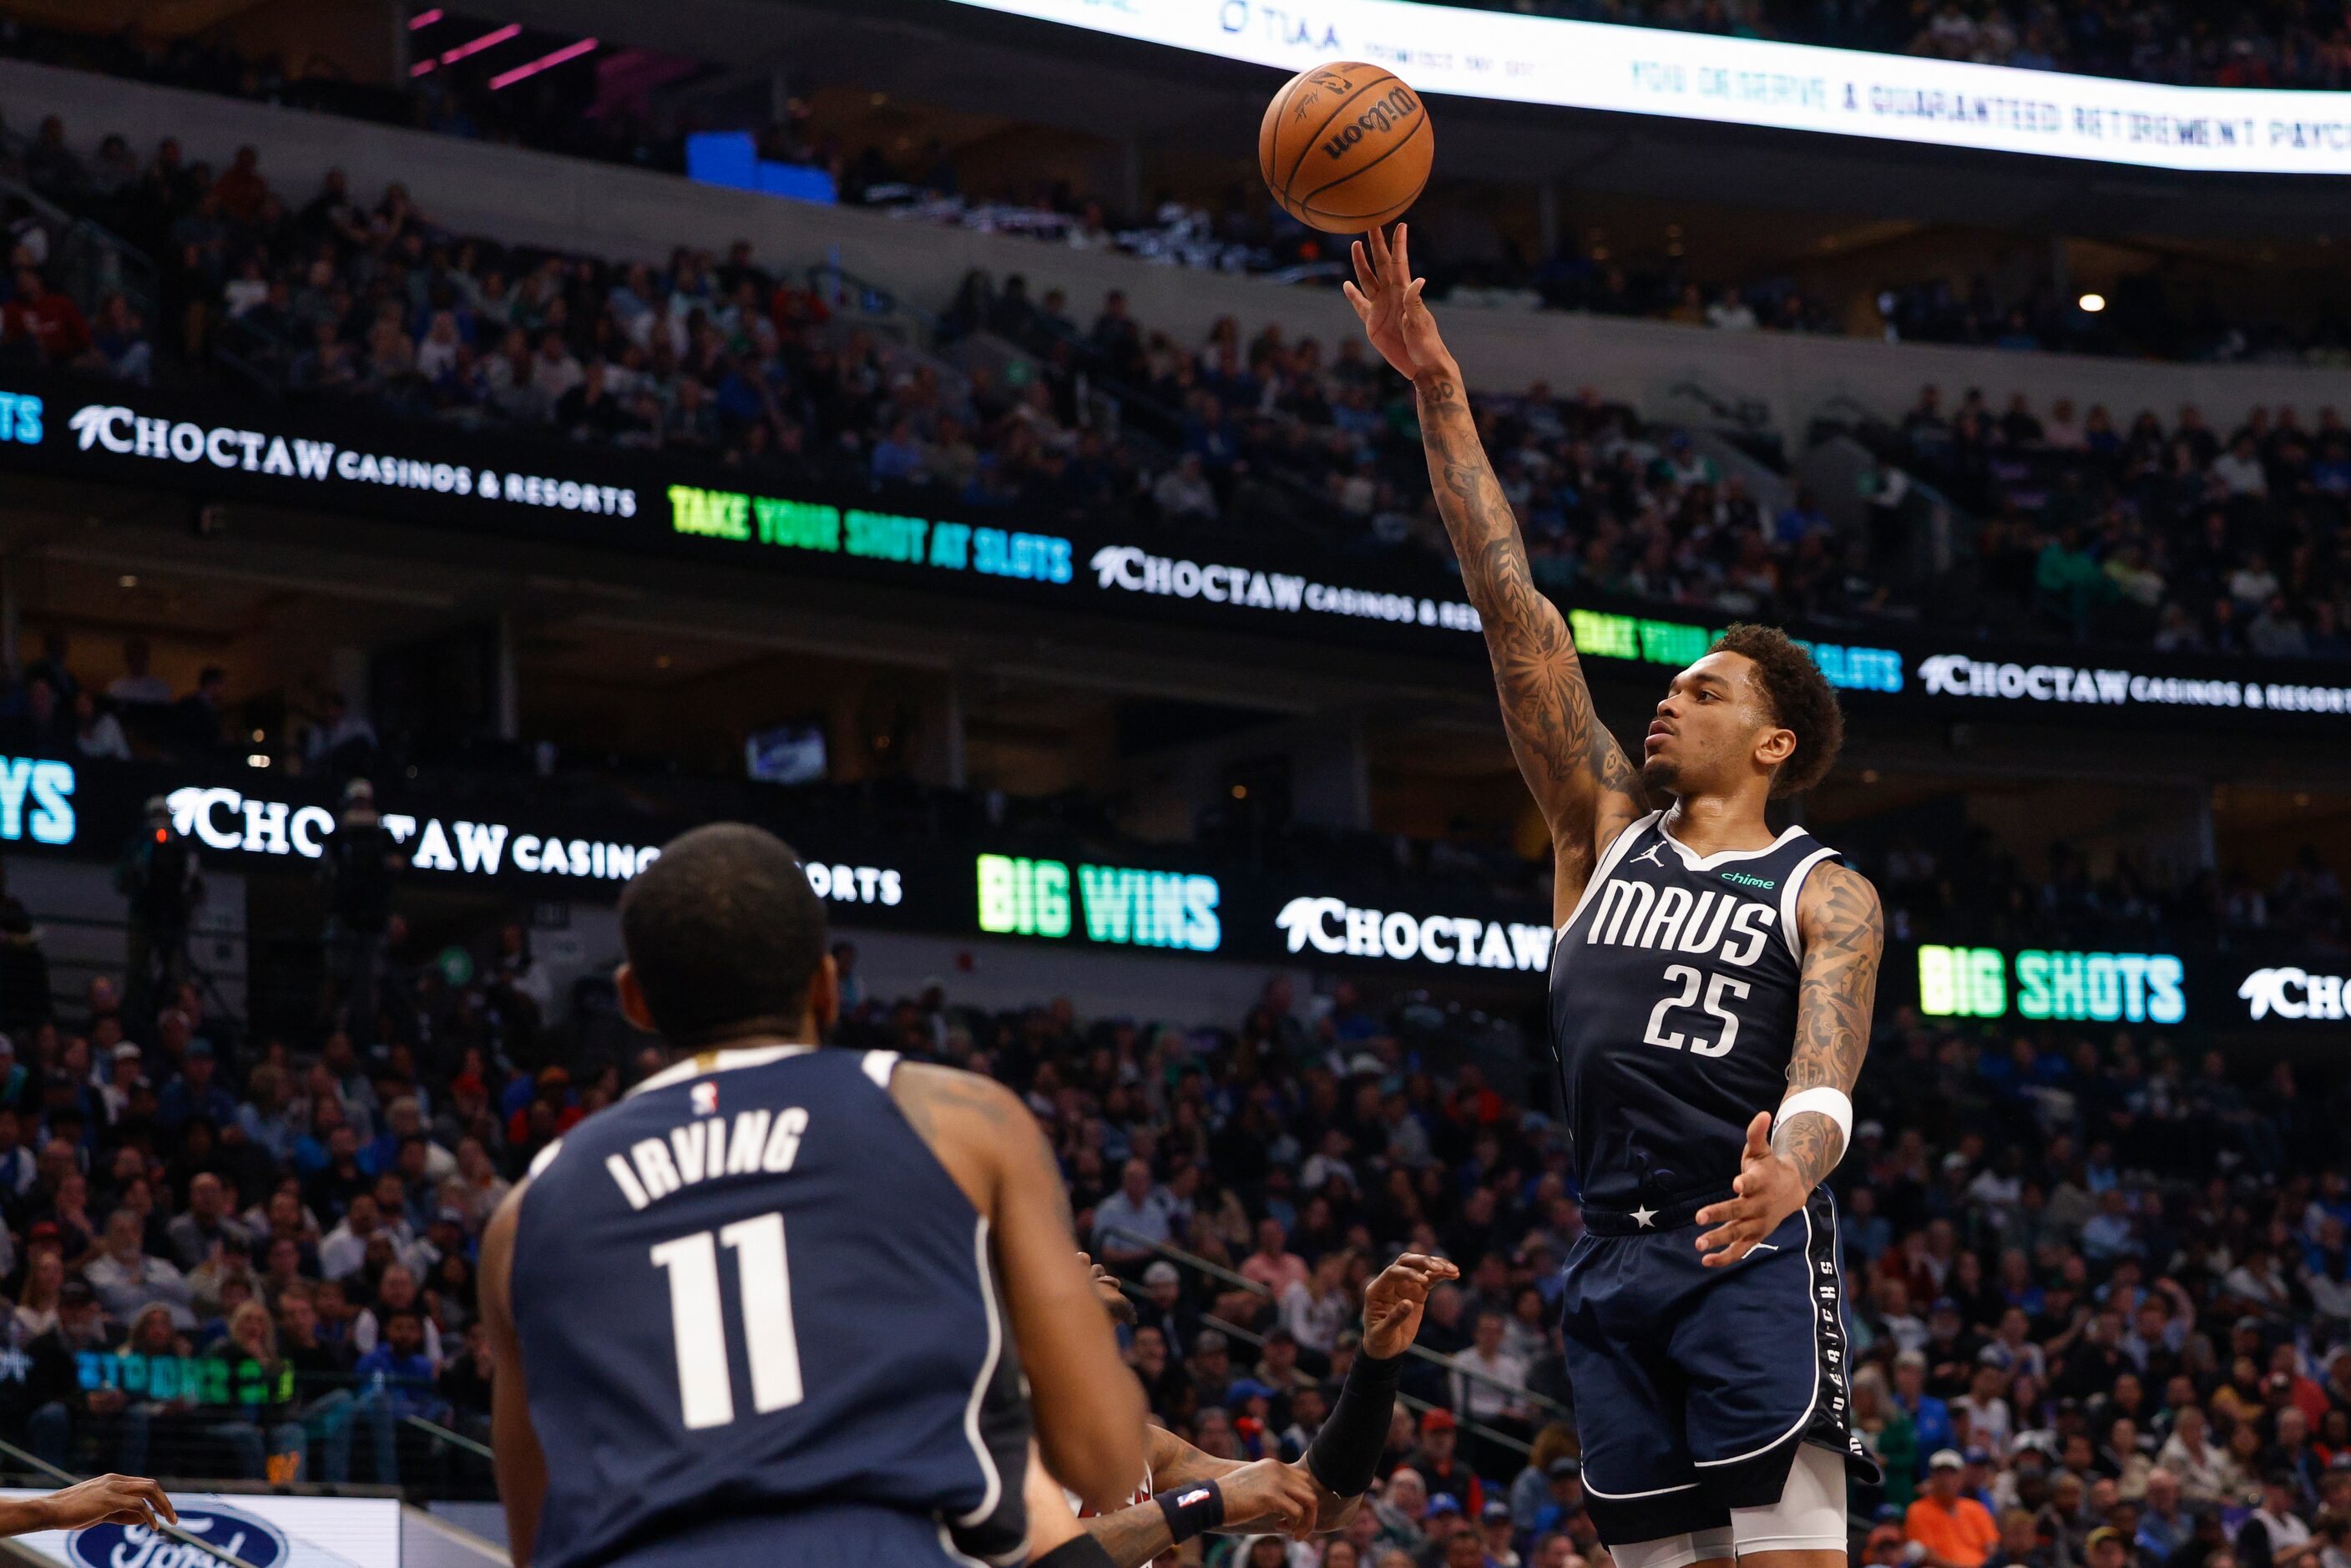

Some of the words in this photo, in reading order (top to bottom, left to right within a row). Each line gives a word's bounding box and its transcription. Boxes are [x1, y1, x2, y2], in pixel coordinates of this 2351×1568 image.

[1322, 86, 1418, 159] Wilson
[2268, 119, 2351, 154] PAYC
[98, 405, 336, 482] CHOCTAW
[336, 450, 473, 496] CASINOS
[477, 469, 500, 500] &
[504, 473, 637, 518] RESORTS
[667, 483, 751, 541] TAKE
[753, 496, 841, 554] YOUR
[844, 508, 929, 564] SHOT
[929, 520, 972, 570] AT
[973, 526, 1073, 584] SLOTS
[1115, 546, 1307, 613] CHOCTAW
[1304, 583, 1417, 625] CASINOS
[1940, 655, 2131, 706] CHOCTAW
[2130, 675, 2242, 708] CASINOS
[193, 786, 509, 875] CHOTAW
[804, 861, 903, 906] ORTS
[976, 852, 1072, 938] BIG
[1076, 863, 1221, 952] WINS
[1586, 878, 1778, 967] MAVS
[1721, 871, 1776, 890] chime
[1307, 896, 1555, 973] CHOCTAW
[1642, 964, 1752, 1058] 25
[1919, 944, 2007, 1018] BIG
[2014, 948, 2187, 1024] SHOTS
[604, 1105, 810, 1211] IRVING
[649, 1211, 805, 1431] 11
[1819, 1260, 1863, 1457] MVERICKS
